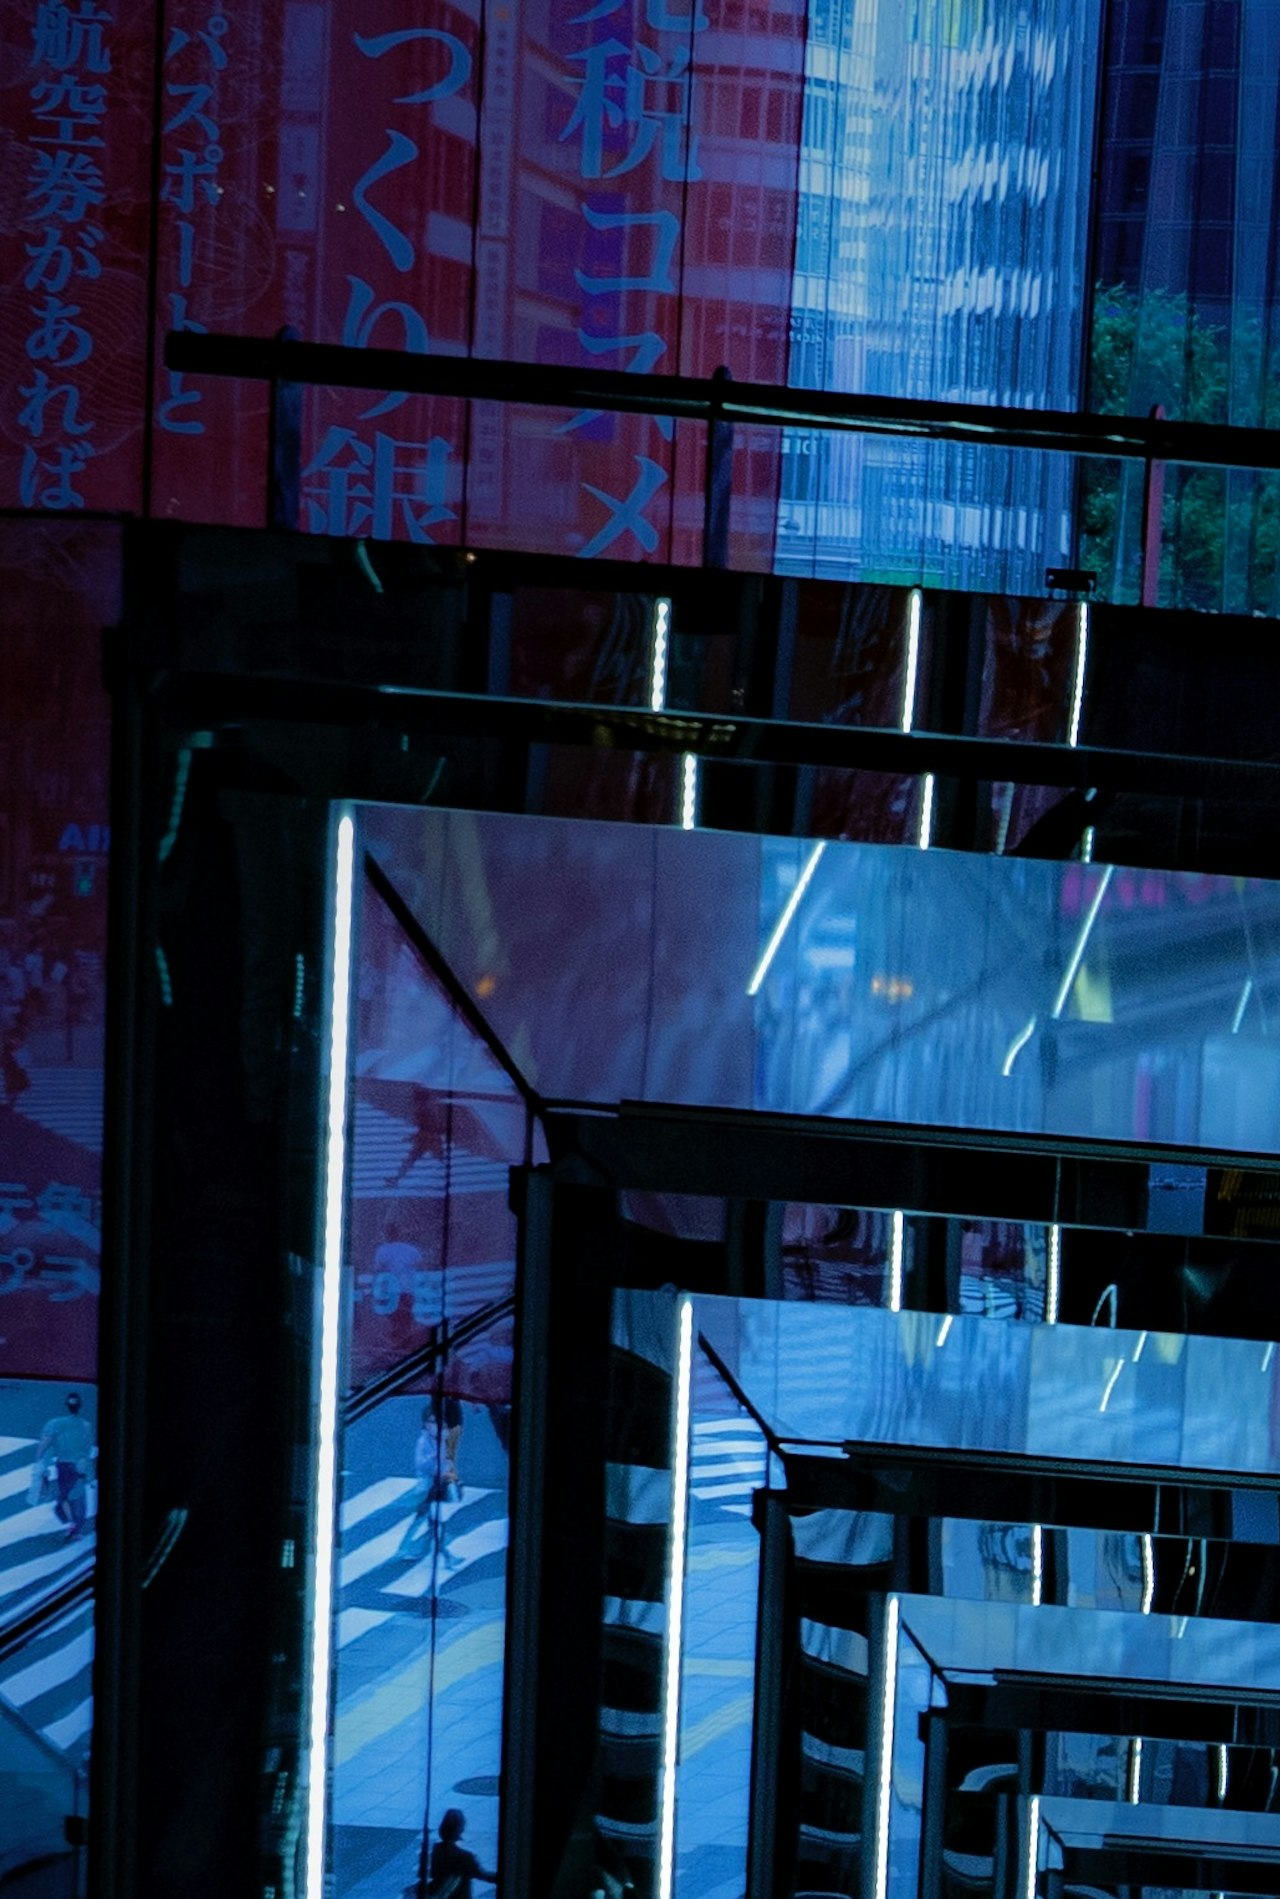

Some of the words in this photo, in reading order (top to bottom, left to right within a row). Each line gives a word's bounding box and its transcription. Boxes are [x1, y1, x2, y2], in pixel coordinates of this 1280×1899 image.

[18, 0, 112, 510] 航空券があれば
